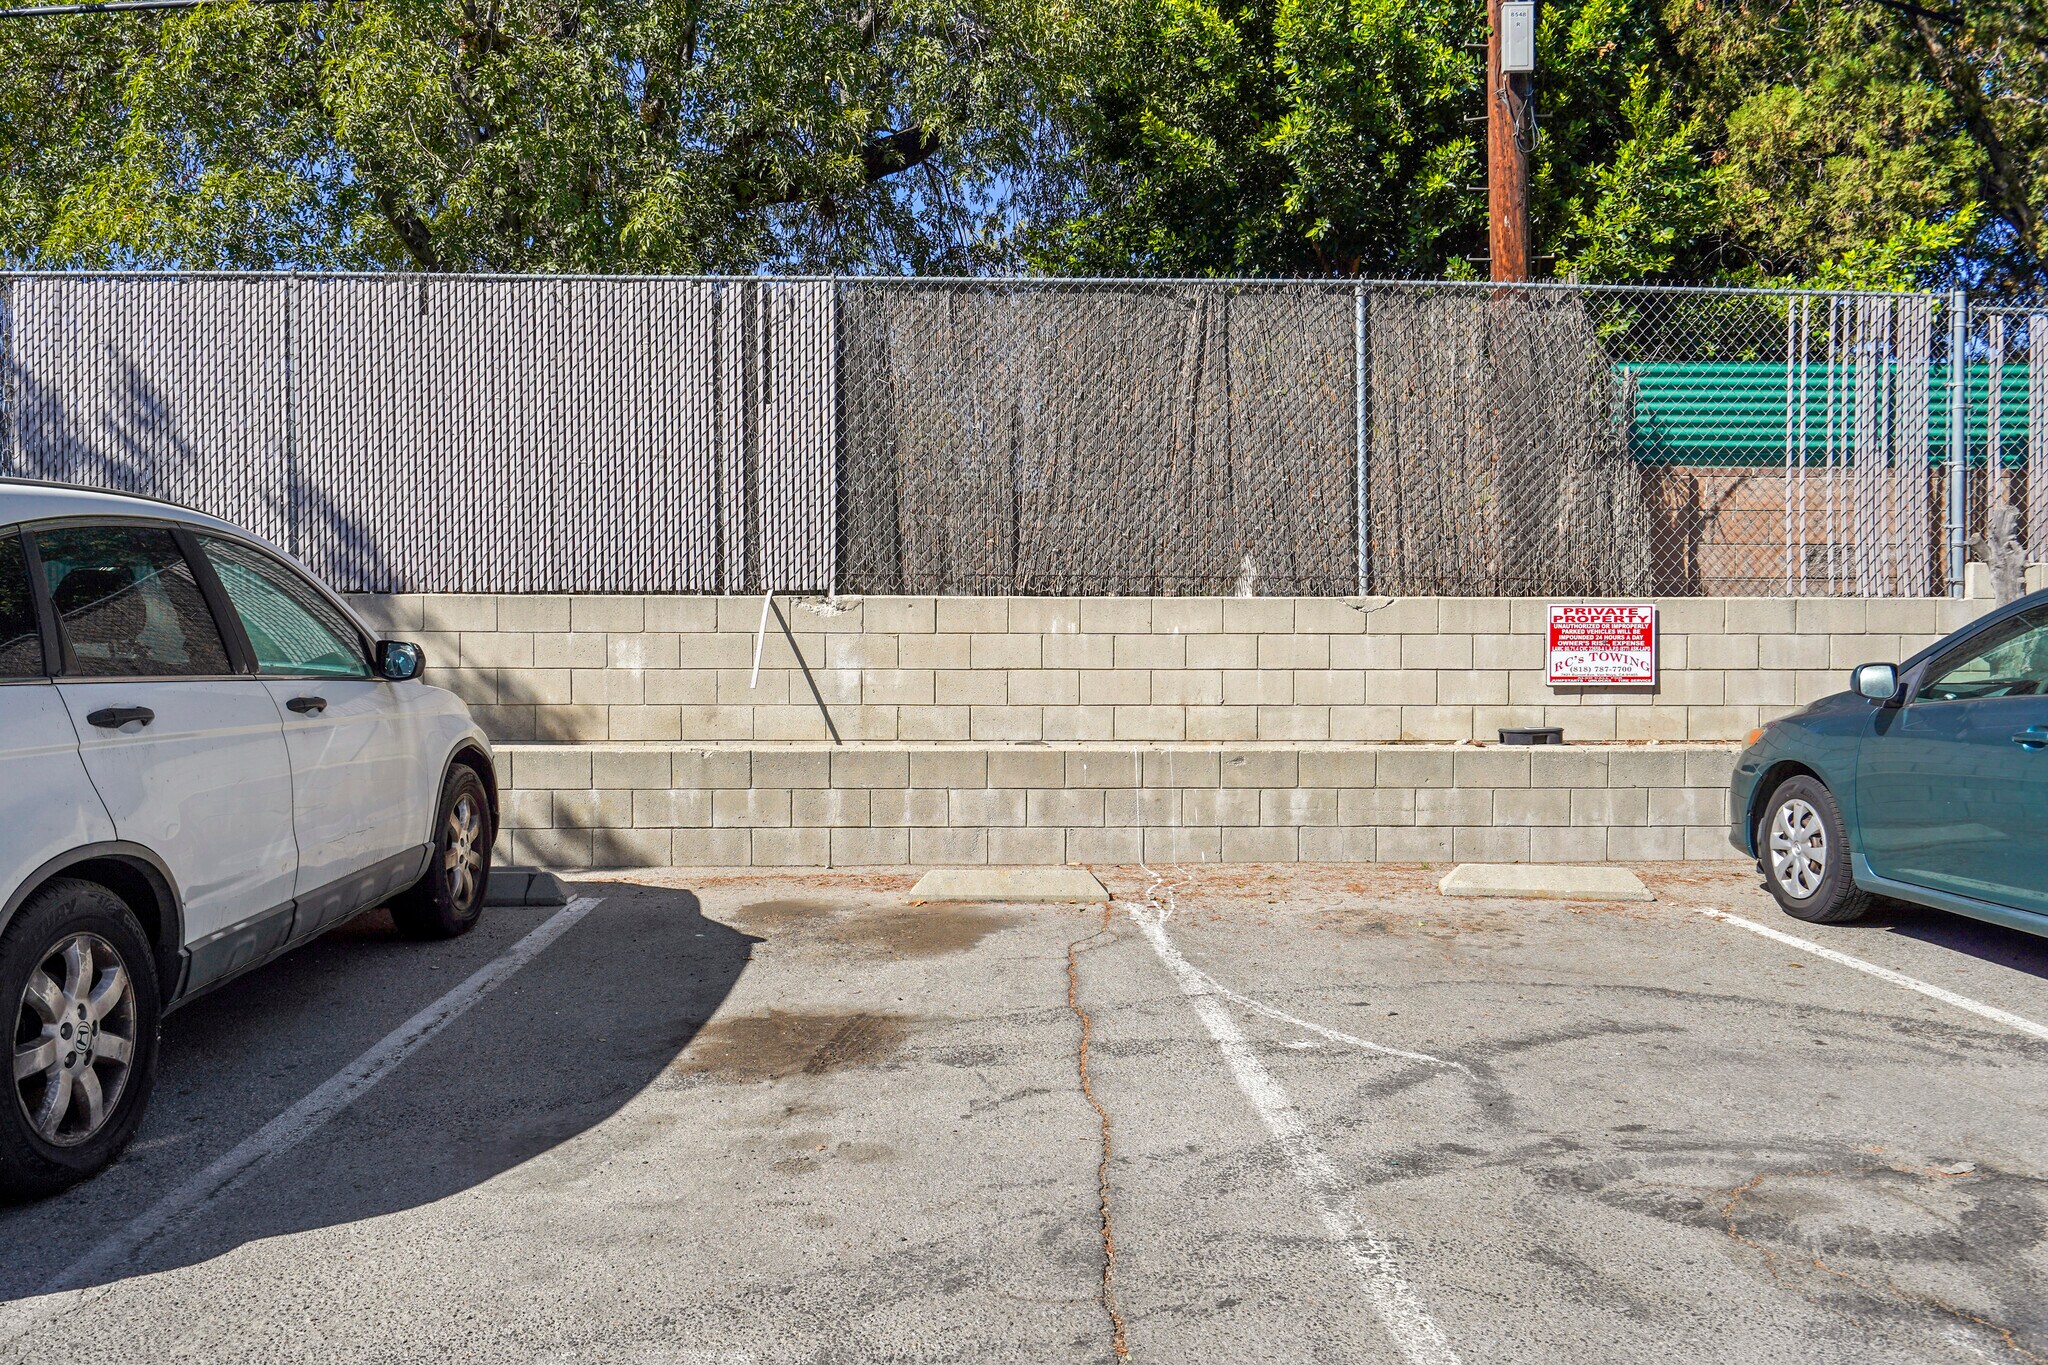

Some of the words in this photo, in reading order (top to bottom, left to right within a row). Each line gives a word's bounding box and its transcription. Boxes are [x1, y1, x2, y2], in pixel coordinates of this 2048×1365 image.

[1563, 607, 1639, 615] PRIVATE
[1553, 615, 1649, 623] PROPERTY
[1554, 655, 1584, 672] RC's
[1588, 651, 1650, 672] TOWING
